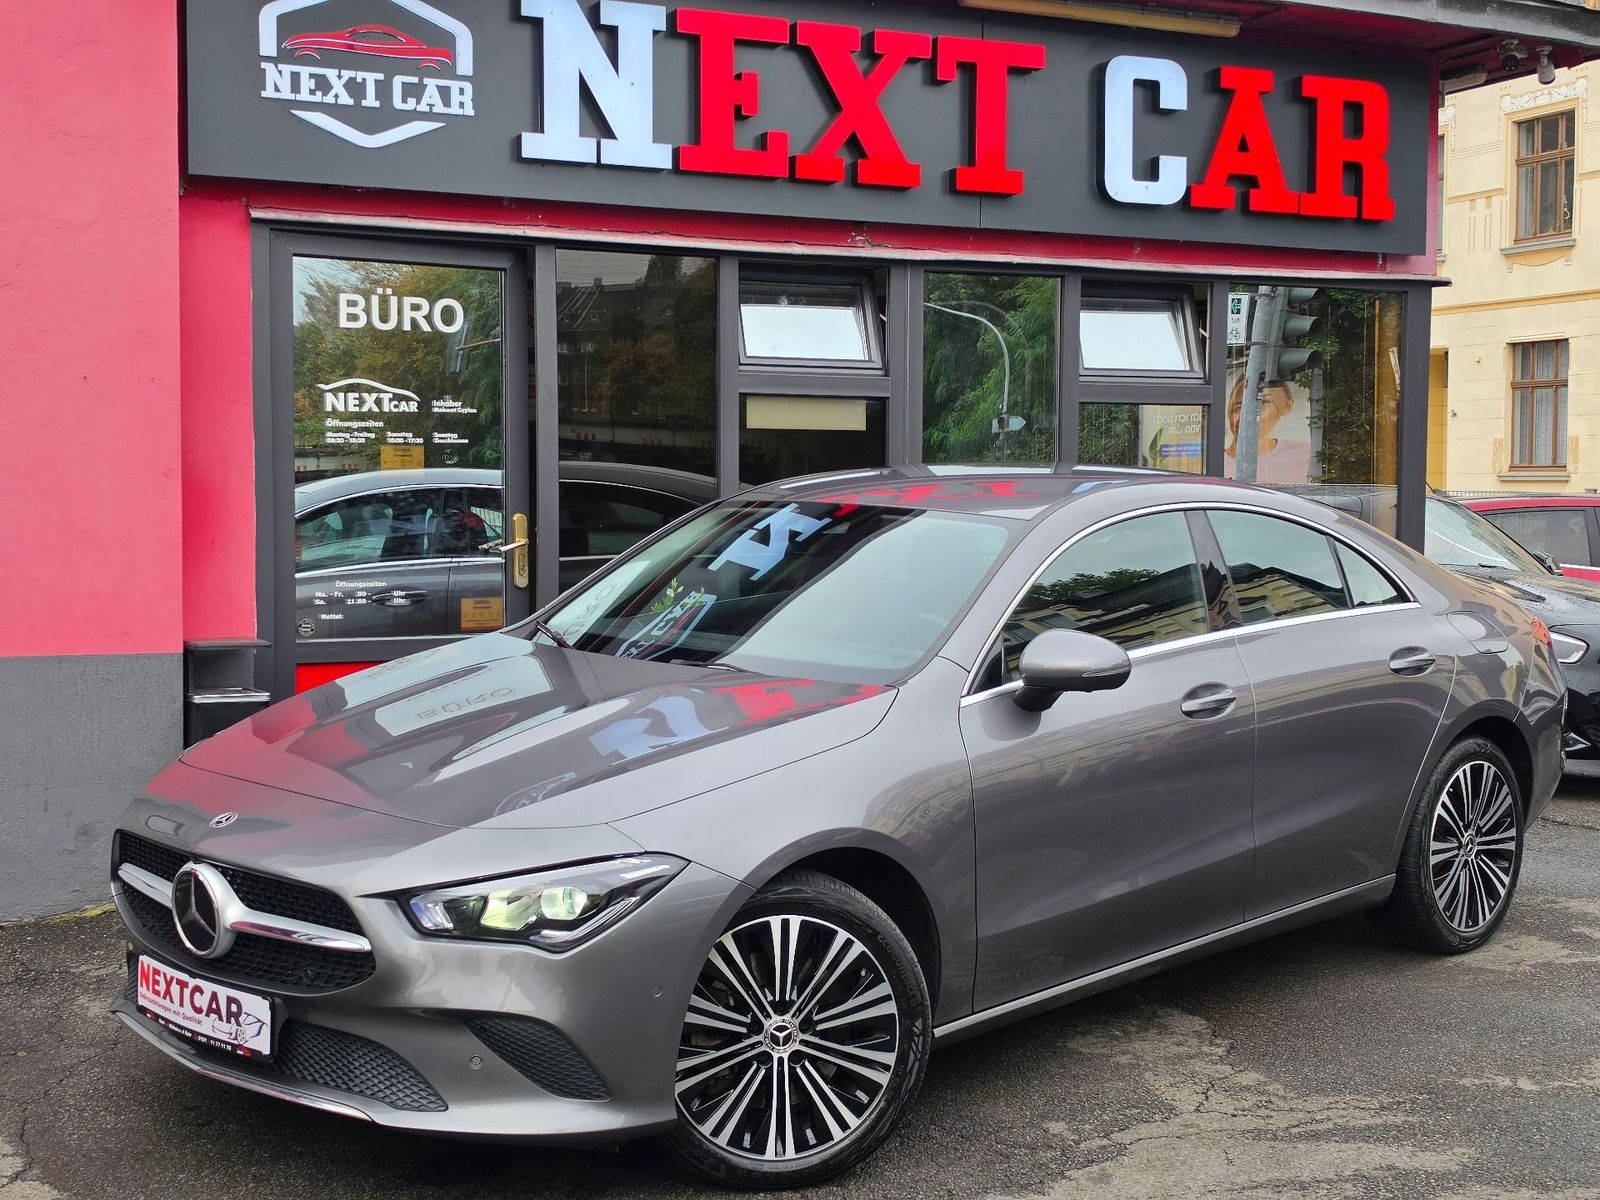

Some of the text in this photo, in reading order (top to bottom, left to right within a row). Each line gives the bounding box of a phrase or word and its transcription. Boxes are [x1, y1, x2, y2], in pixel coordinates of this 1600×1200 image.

[260, 62, 475, 117] NEXT CAR
[520, 0, 1395, 221] NEXT CAR
[337, 287, 465, 334] BÜRO
[432, 400, 463, 408] Inhaber
[325, 418, 385, 428] Öffnungszeiten
[433, 432, 458, 440] Sonntag
[335, 580, 387, 589] Öffnungszeiten
[139, 959, 243, 1028] NEXTCAR
